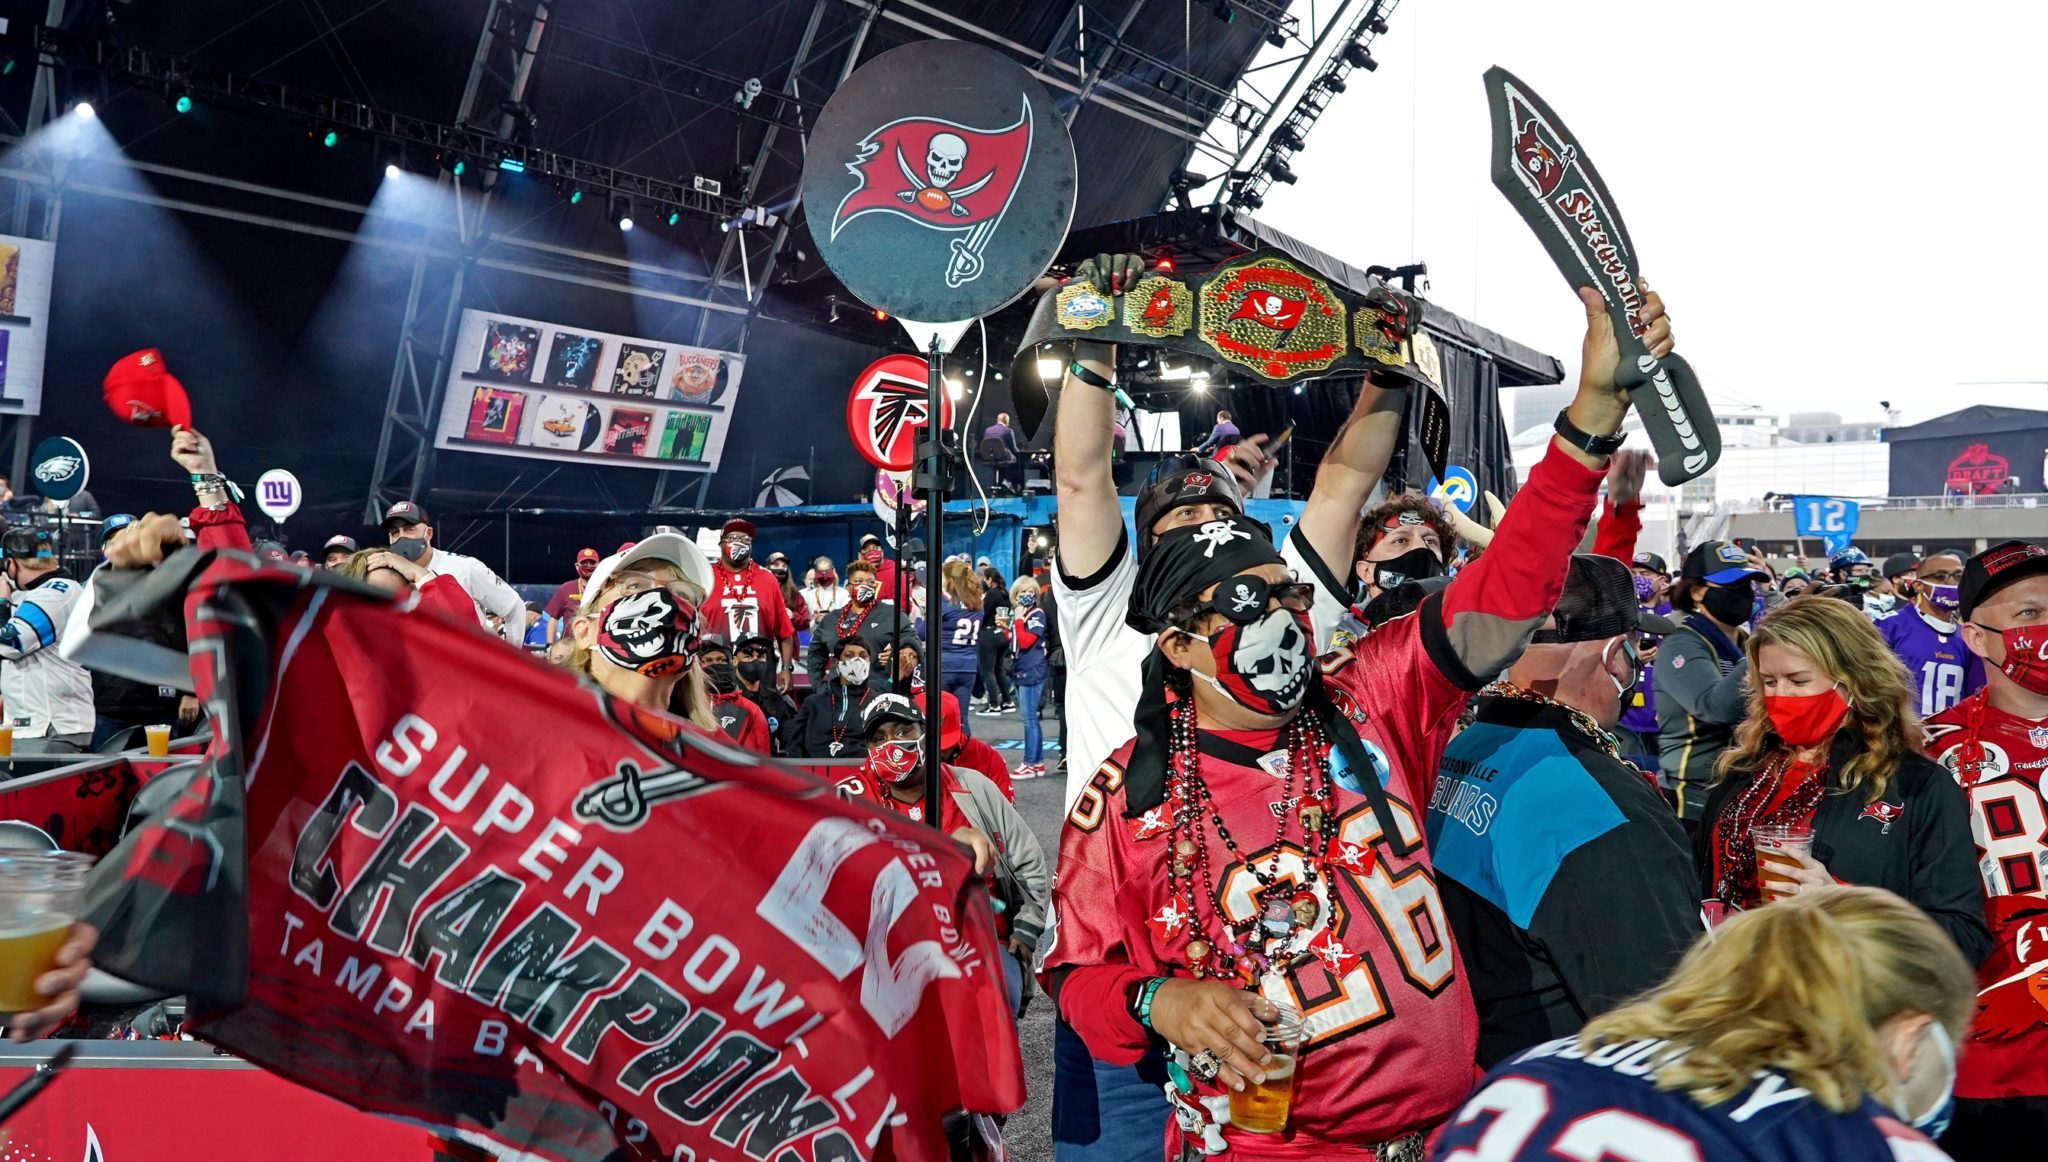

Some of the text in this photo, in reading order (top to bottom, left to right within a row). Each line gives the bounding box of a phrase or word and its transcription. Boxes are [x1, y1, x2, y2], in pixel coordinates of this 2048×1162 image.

[679, 354, 720, 370] BUCCANEERS
[1953, 468, 2003, 480] DRAFT
[1807, 499, 1847, 532] 12
[952, 618, 980, 645] 21
[1921, 661, 1965, 716] 18
[1427, 775, 1498, 836] GUARS
[375, 714, 623, 915] SUPER
[633, 897, 824, 1058] BOWL
[868, 818, 982, 978] SPER BOWL
[1214, 792, 1456, 1052] 26
[279, 912, 435, 1041] TAMPA
